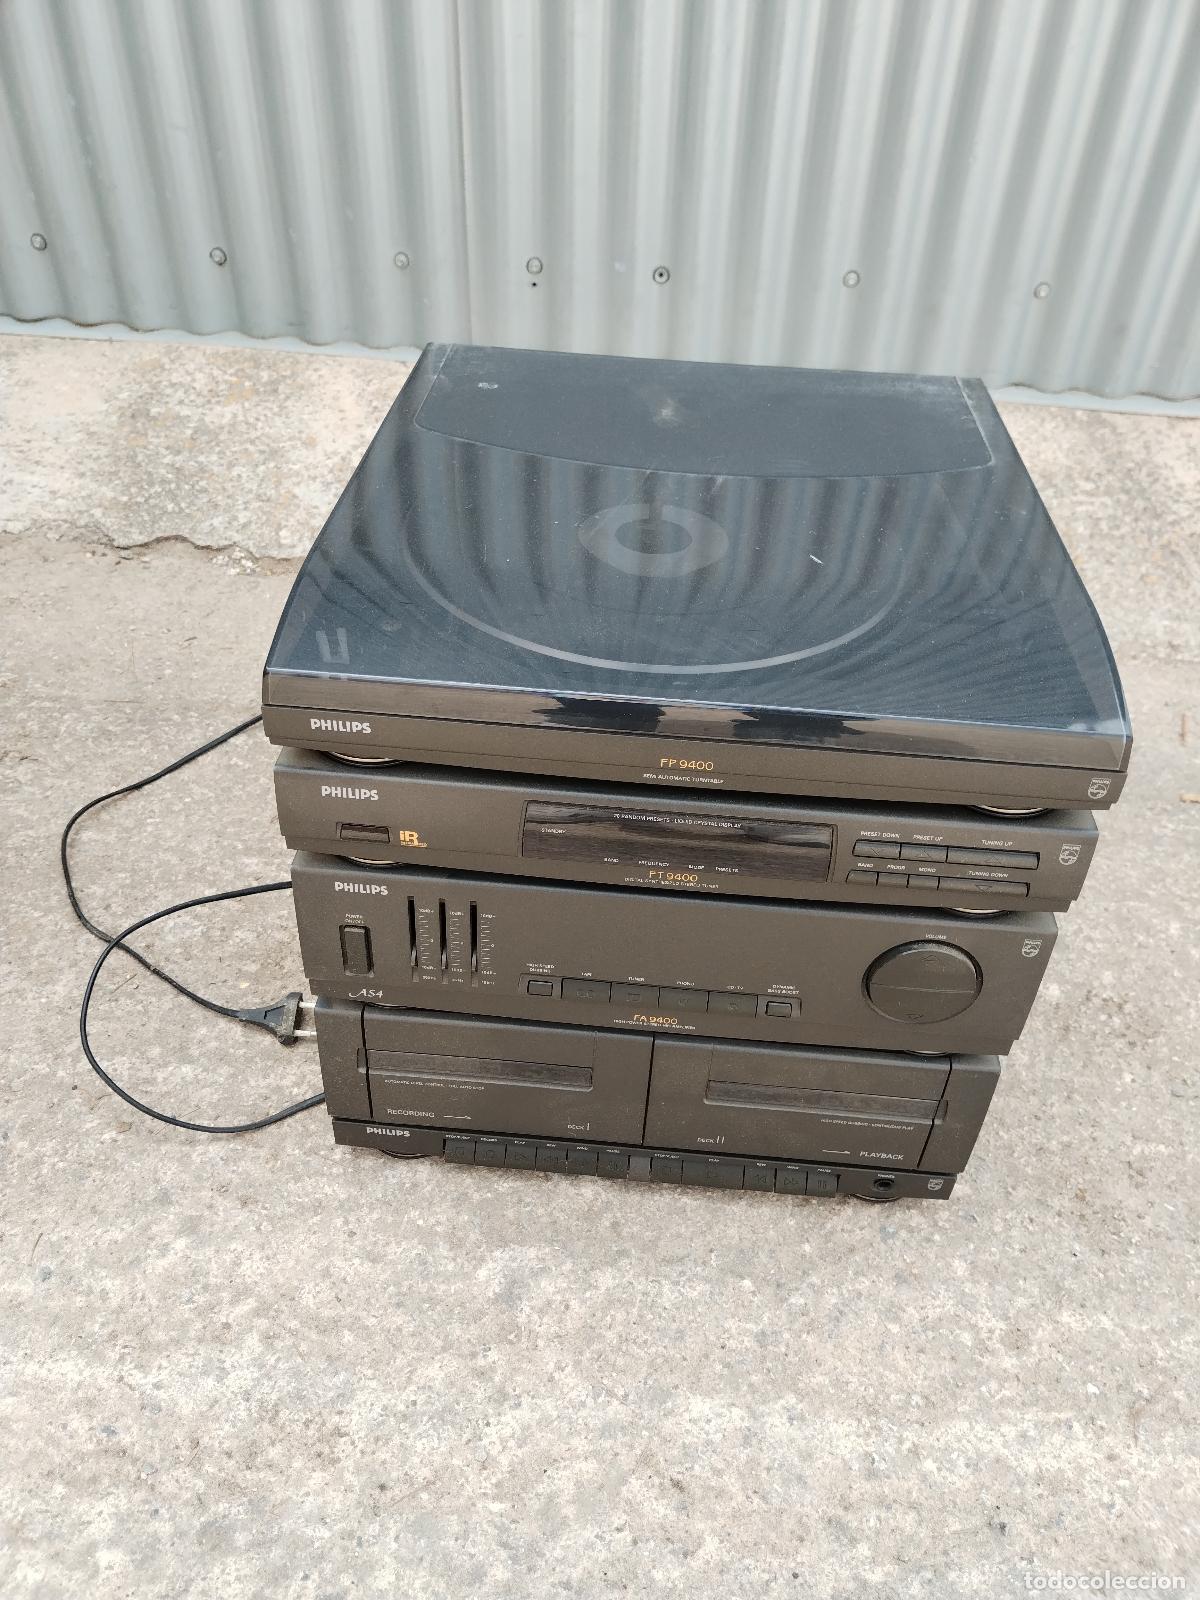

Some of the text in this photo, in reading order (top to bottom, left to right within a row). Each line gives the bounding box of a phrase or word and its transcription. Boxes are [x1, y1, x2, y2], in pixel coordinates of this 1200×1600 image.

[310, 718, 372, 734] PHILIPS
[679, 760, 714, 771] 9400
[321, 785, 379, 800] PHILIPS
[666, 872, 698, 882] 9400
[334, 881, 389, 896] PHILIPS
[649, 1016, 678, 1025] 9400
[387, 1108, 435, 1118] RECORDING
[366, 1126, 411, 1138] PHILIPS
[860, 1151, 905, 1160] PLAYBACK
